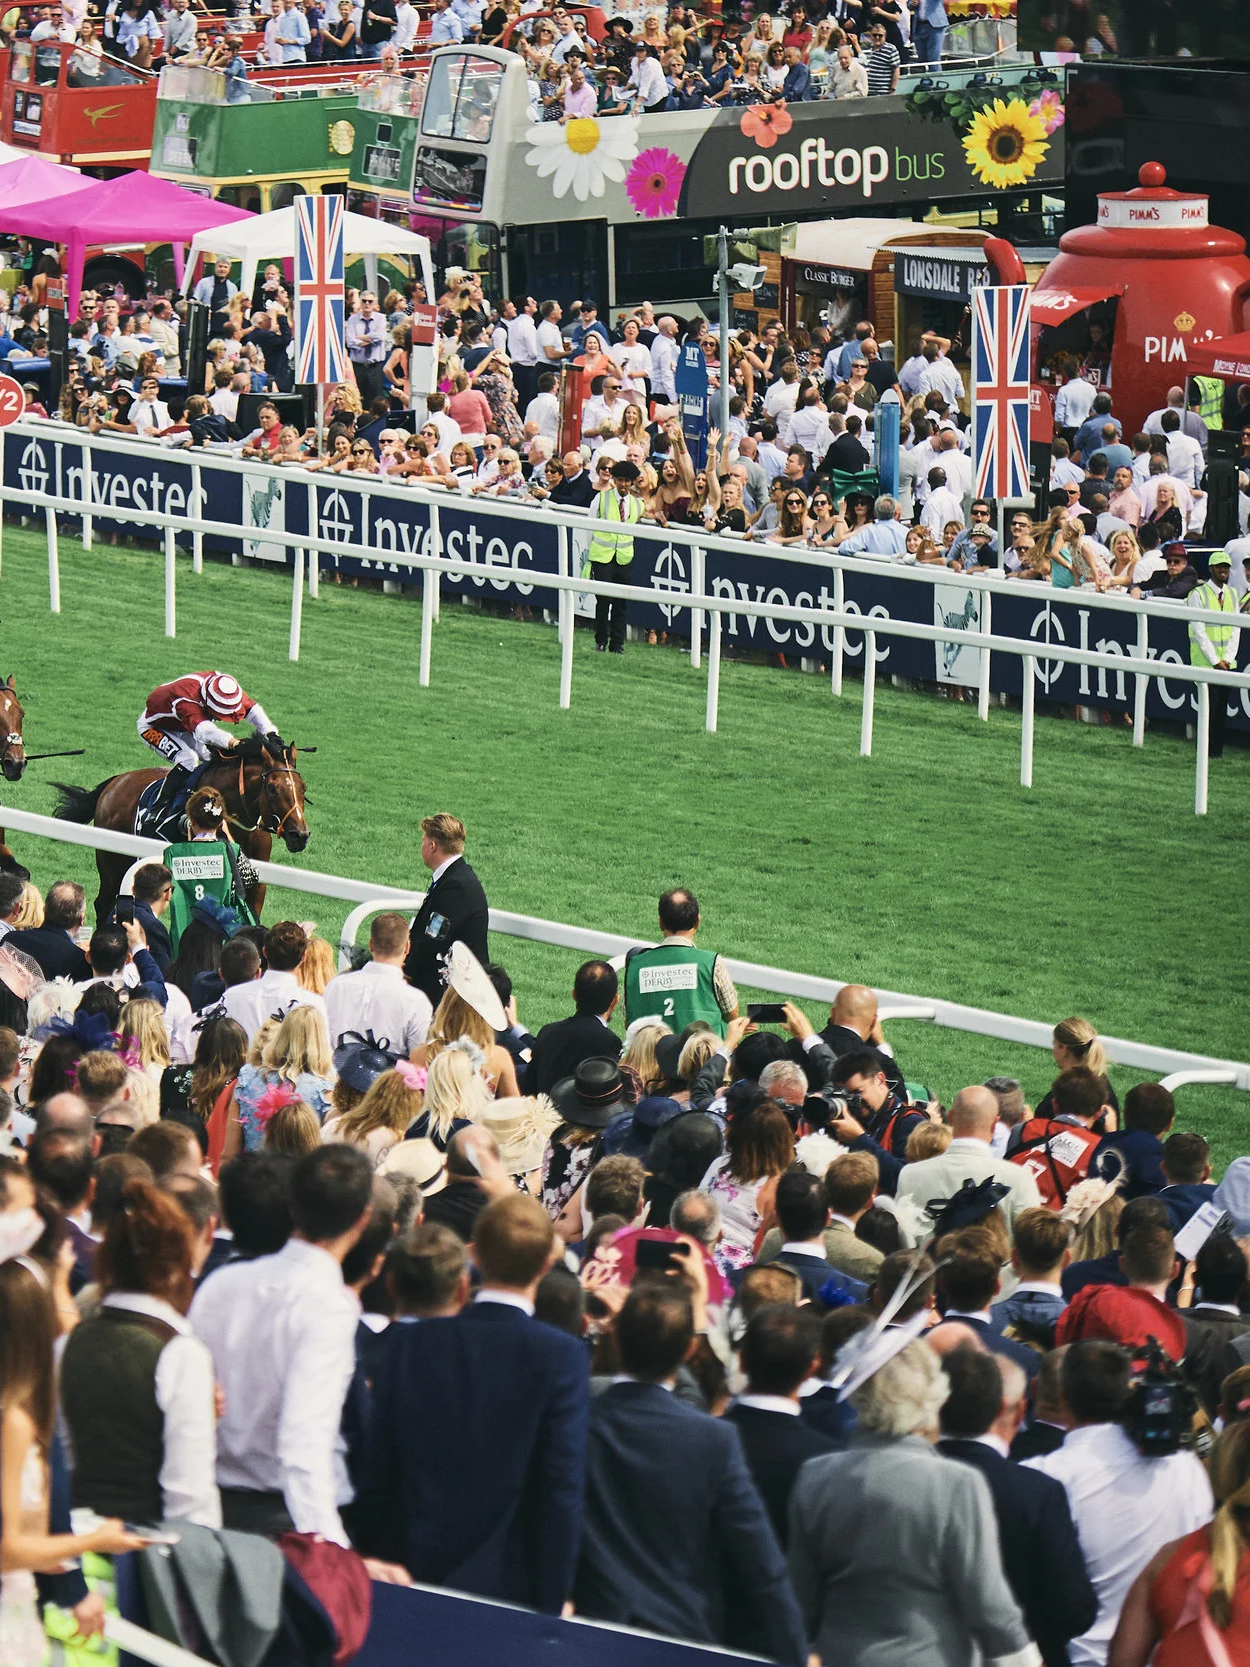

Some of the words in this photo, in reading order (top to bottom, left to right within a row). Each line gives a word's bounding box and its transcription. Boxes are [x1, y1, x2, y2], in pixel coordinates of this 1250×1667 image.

[729, 137, 889, 198] rooftop
[895, 146, 946, 181] bus
[1129, 207, 1160, 220] PIMM'S
[903, 258, 960, 293] LONSDALE
[54, 442, 208, 536] Investec
[361, 493, 534, 596] Investec
[177, 867, 202, 875] DERBY
[195, 885, 204, 900] 8
[651, 969, 694, 978] Investec
[644, 977, 672, 987] DERBY
[663, 998, 674, 1016] 2
